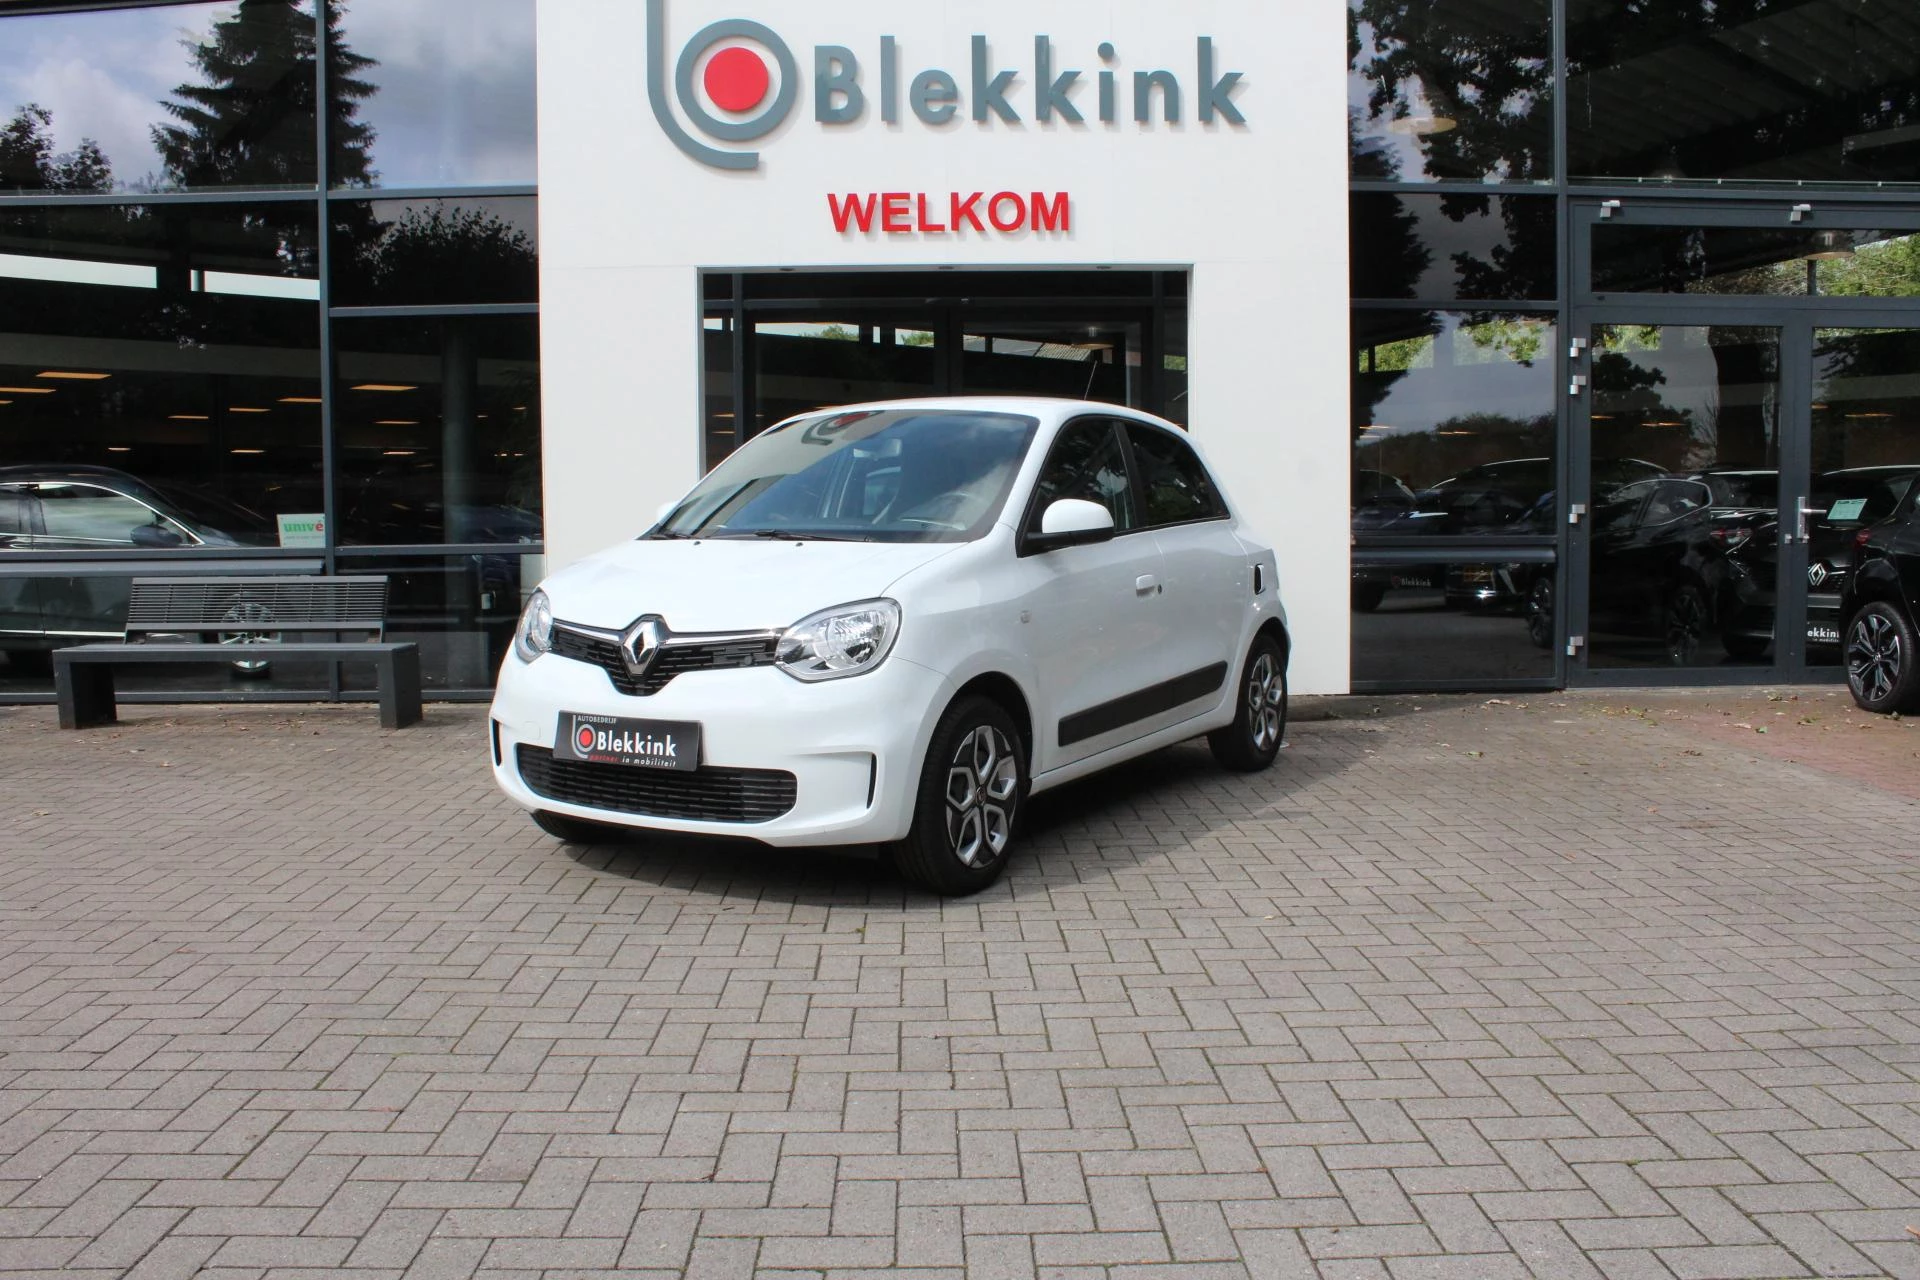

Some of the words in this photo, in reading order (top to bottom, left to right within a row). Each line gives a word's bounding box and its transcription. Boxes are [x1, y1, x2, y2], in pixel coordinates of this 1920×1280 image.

[814, 35, 1247, 125] Blekkink
[827, 191, 1070, 233] WELKOM
[597, 730, 677, 757] Blekkink
[622, 755, 630, 763] in
[633, 758, 677, 768] mobiliteit
